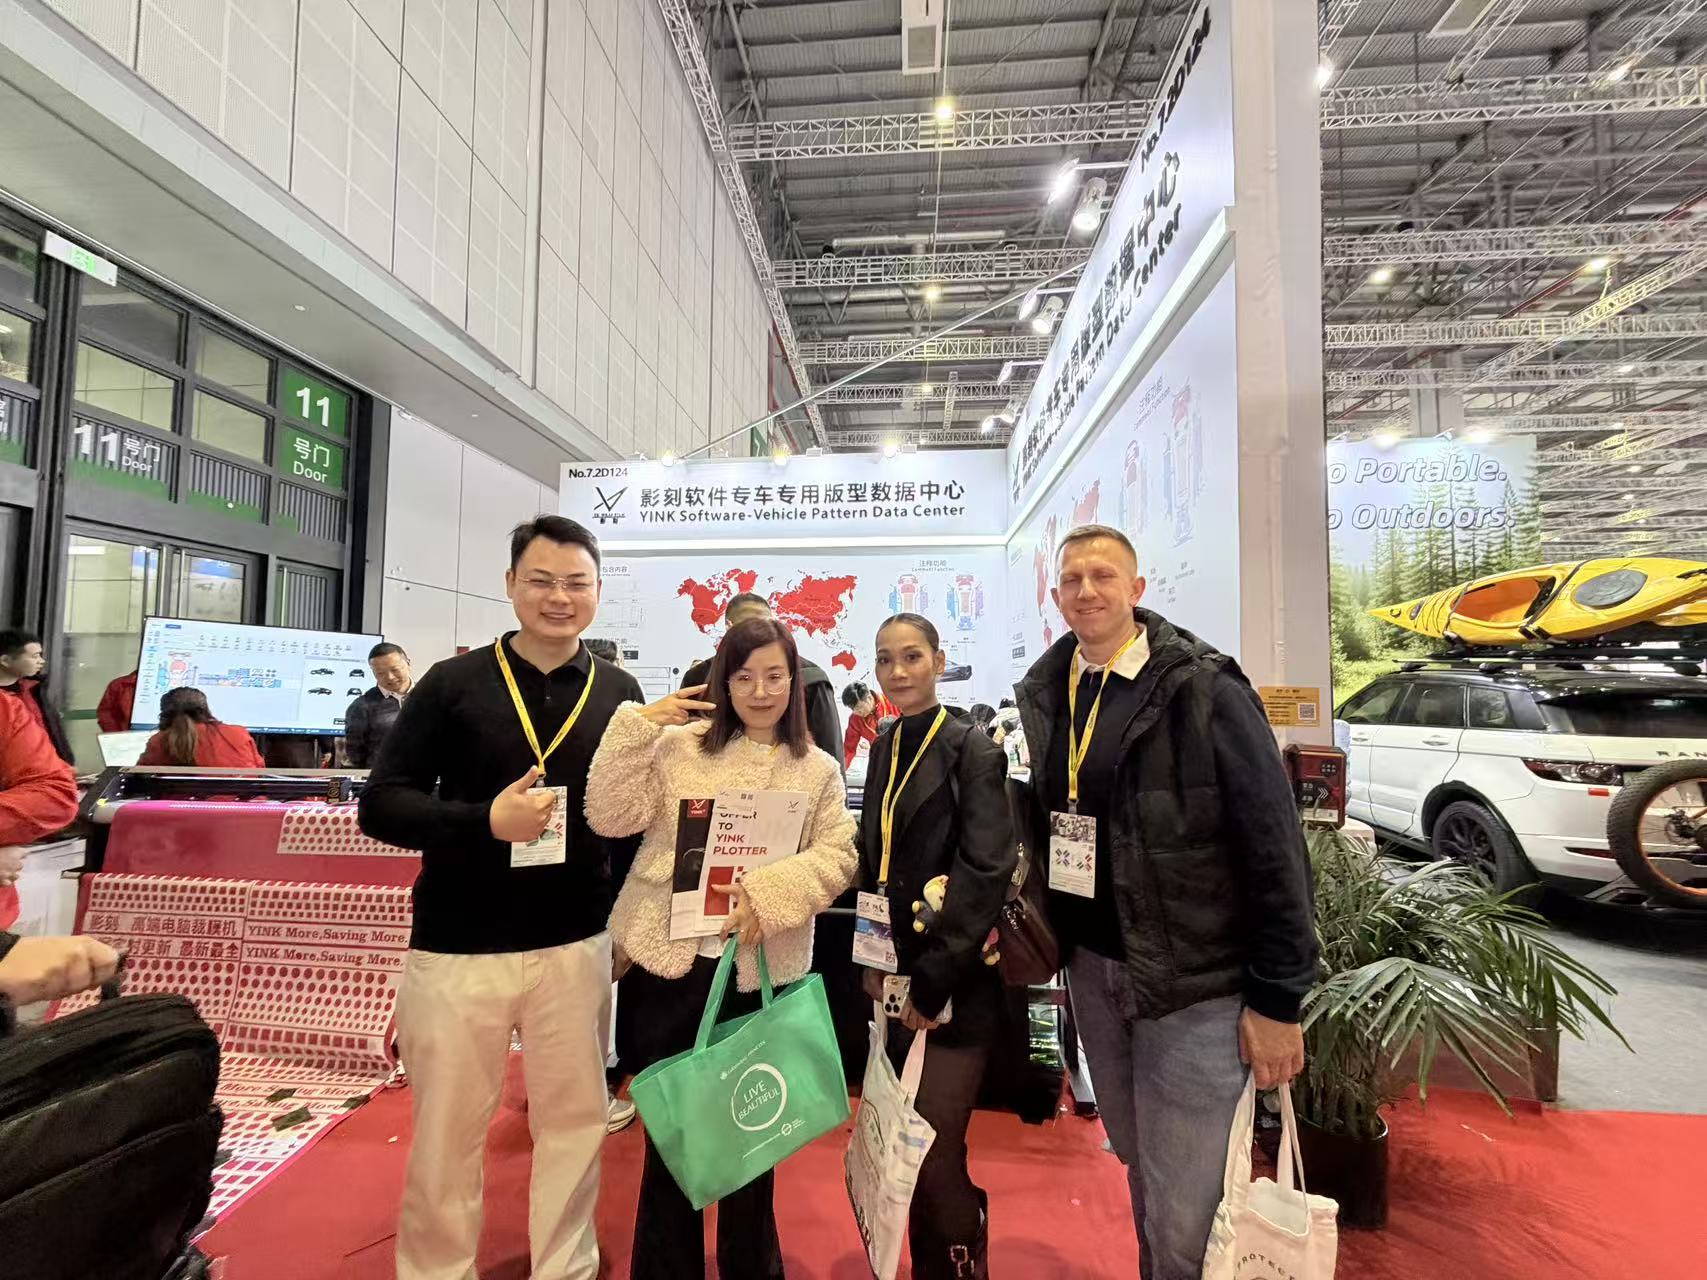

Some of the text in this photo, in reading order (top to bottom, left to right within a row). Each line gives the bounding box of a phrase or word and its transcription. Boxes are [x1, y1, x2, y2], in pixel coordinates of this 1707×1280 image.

[1134, 202, 1182, 298] Center
[296, 386, 330, 427] 11
[74, 424, 161, 462] 11 号门
[293, 437, 330, 468] 号门
[122, 455, 153, 472] Door
[293, 460, 328, 483] Door
[568, 467, 628, 479] No.7.2D124
[1355, 453, 1508, 483] Portable.
[640, 479, 965, 508] 影刻软件专车专用版型数据中心
[640, 510, 676, 523] YINK
[680, 507, 807, 522] Software-Vehicle
[812, 506, 868, 520] Pattern
[873, 505, 908, 518] Data
[913, 503, 965, 517] Center
[1352, 501, 1516, 529] Outdoors.
[718, 822, 733, 831] TO
[716, 834, 745, 843] YINK
[713, 846, 768, 856] PLOTTER
[249, 925, 408, 944] YINK More,Saving More.
[246, 946, 404, 967] YINK More,Saving More.
[743, 1080, 767, 1103] LIVE
[738, 1088, 780, 1120] BEAUTIFUL
